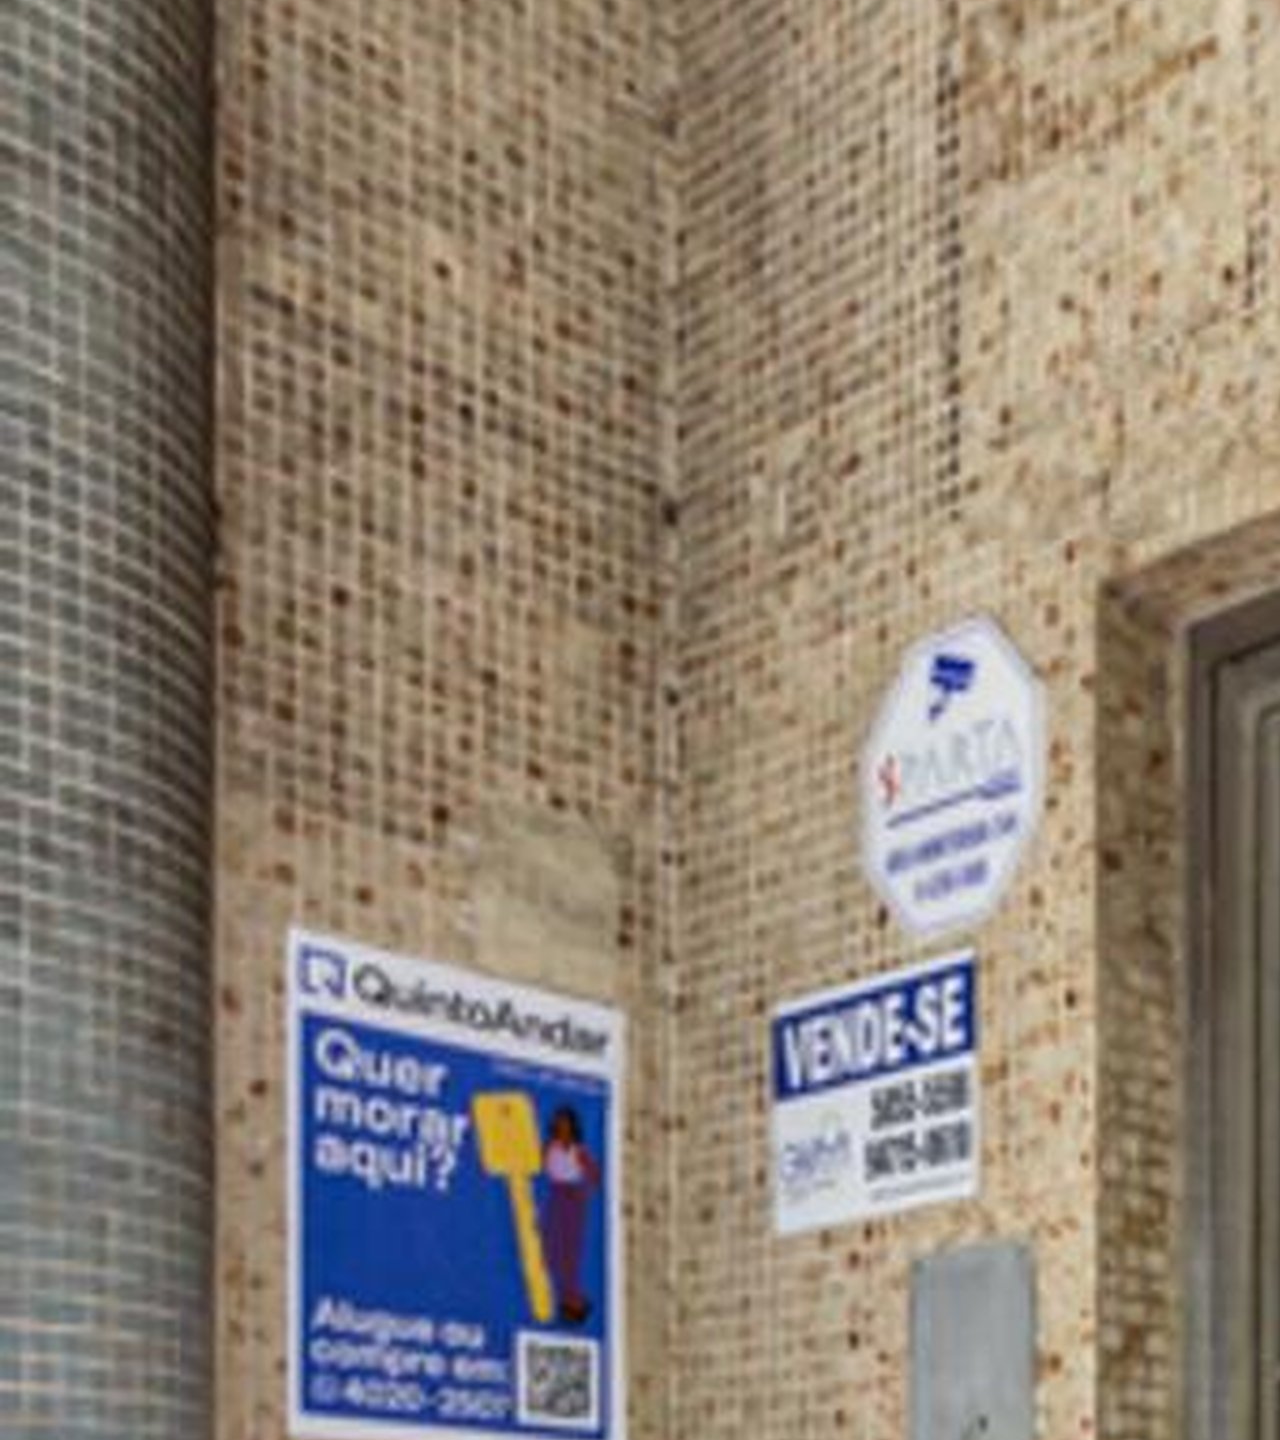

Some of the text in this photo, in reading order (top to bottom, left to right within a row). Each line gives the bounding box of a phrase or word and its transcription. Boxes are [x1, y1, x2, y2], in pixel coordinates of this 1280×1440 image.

[352, 962, 608, 1053] QuintoAndar
[783, 975, 969, 1090] VENDE-SE
[314, 1027, 448, 1097] Quer
[314, 1085, 468, 1148] morar
[314, 1134, 457, 1190] aqui?
